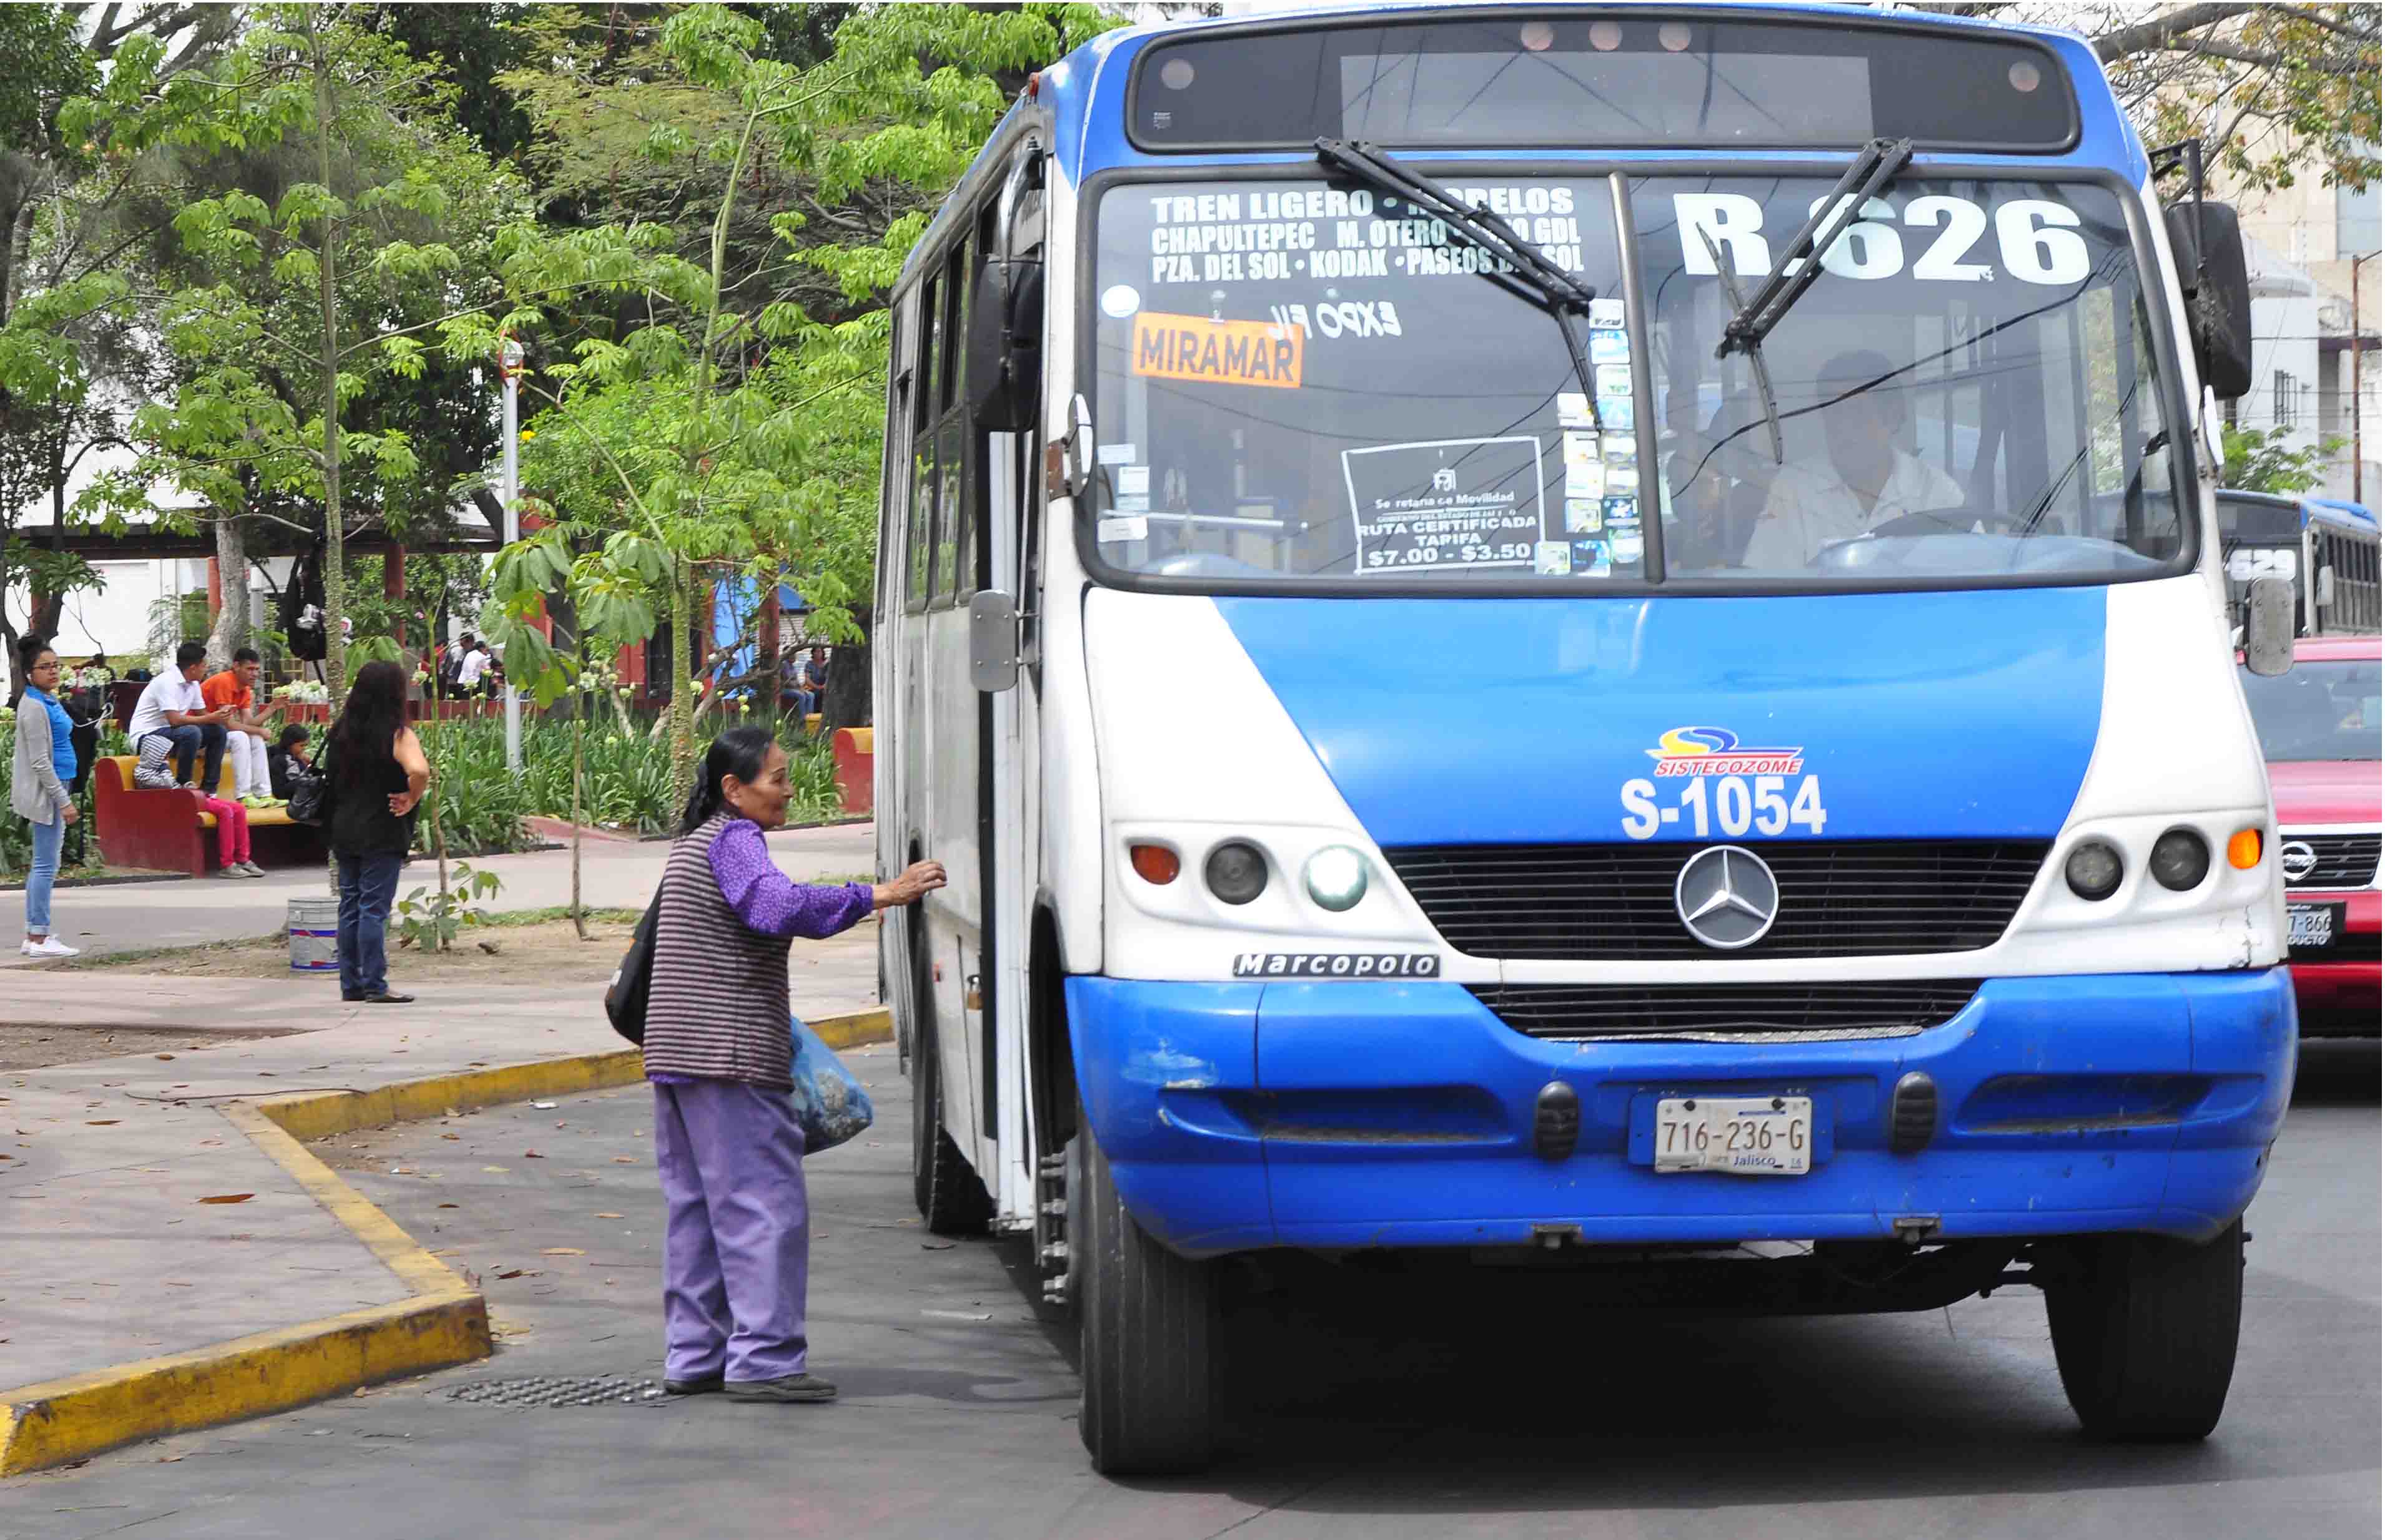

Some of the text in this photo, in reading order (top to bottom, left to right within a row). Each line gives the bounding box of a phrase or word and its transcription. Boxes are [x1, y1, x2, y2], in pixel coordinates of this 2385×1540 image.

[1150, 187, 1574, 223] TREN LIGERO RELOS
[1151, 222, 1316, 255] CHAPULTEPEC
[1336, 220, 1366, 249] M.
[1369, 218, 1447, 248] OTERO
[1534, 217, 1582, 245] GDL
[1152, 255, 1200, 283] PZA.
[1204, 253, 1244, 281] DEL
[1248, 251, 1291, 280] SOL
[1309, 249, 1388, 278] KODAK
[1406, 246, 1494, 276] PASEOS
[1139, 326, 1295, 382] MIRAMAR
[1456, 491, 1515, 504] Movilidad
[1359, 523, 1408, 536] RUTA
[1413, 516, 1537, 534] CERTIFICADA
[1368, 547, 1438, 567] $7.00
[1461, 543, 1531, 562] $3.50
[1655, 759, 1803, 776] SISTECOZOME
[1620, 774, 1827, 841] S-1054
[1237, 953, 1435, 975] Marcopolo
[1662, 1119, 1804, 1152] 716-236-G
[1733, 1154, 1776, 1167] Jalisco
